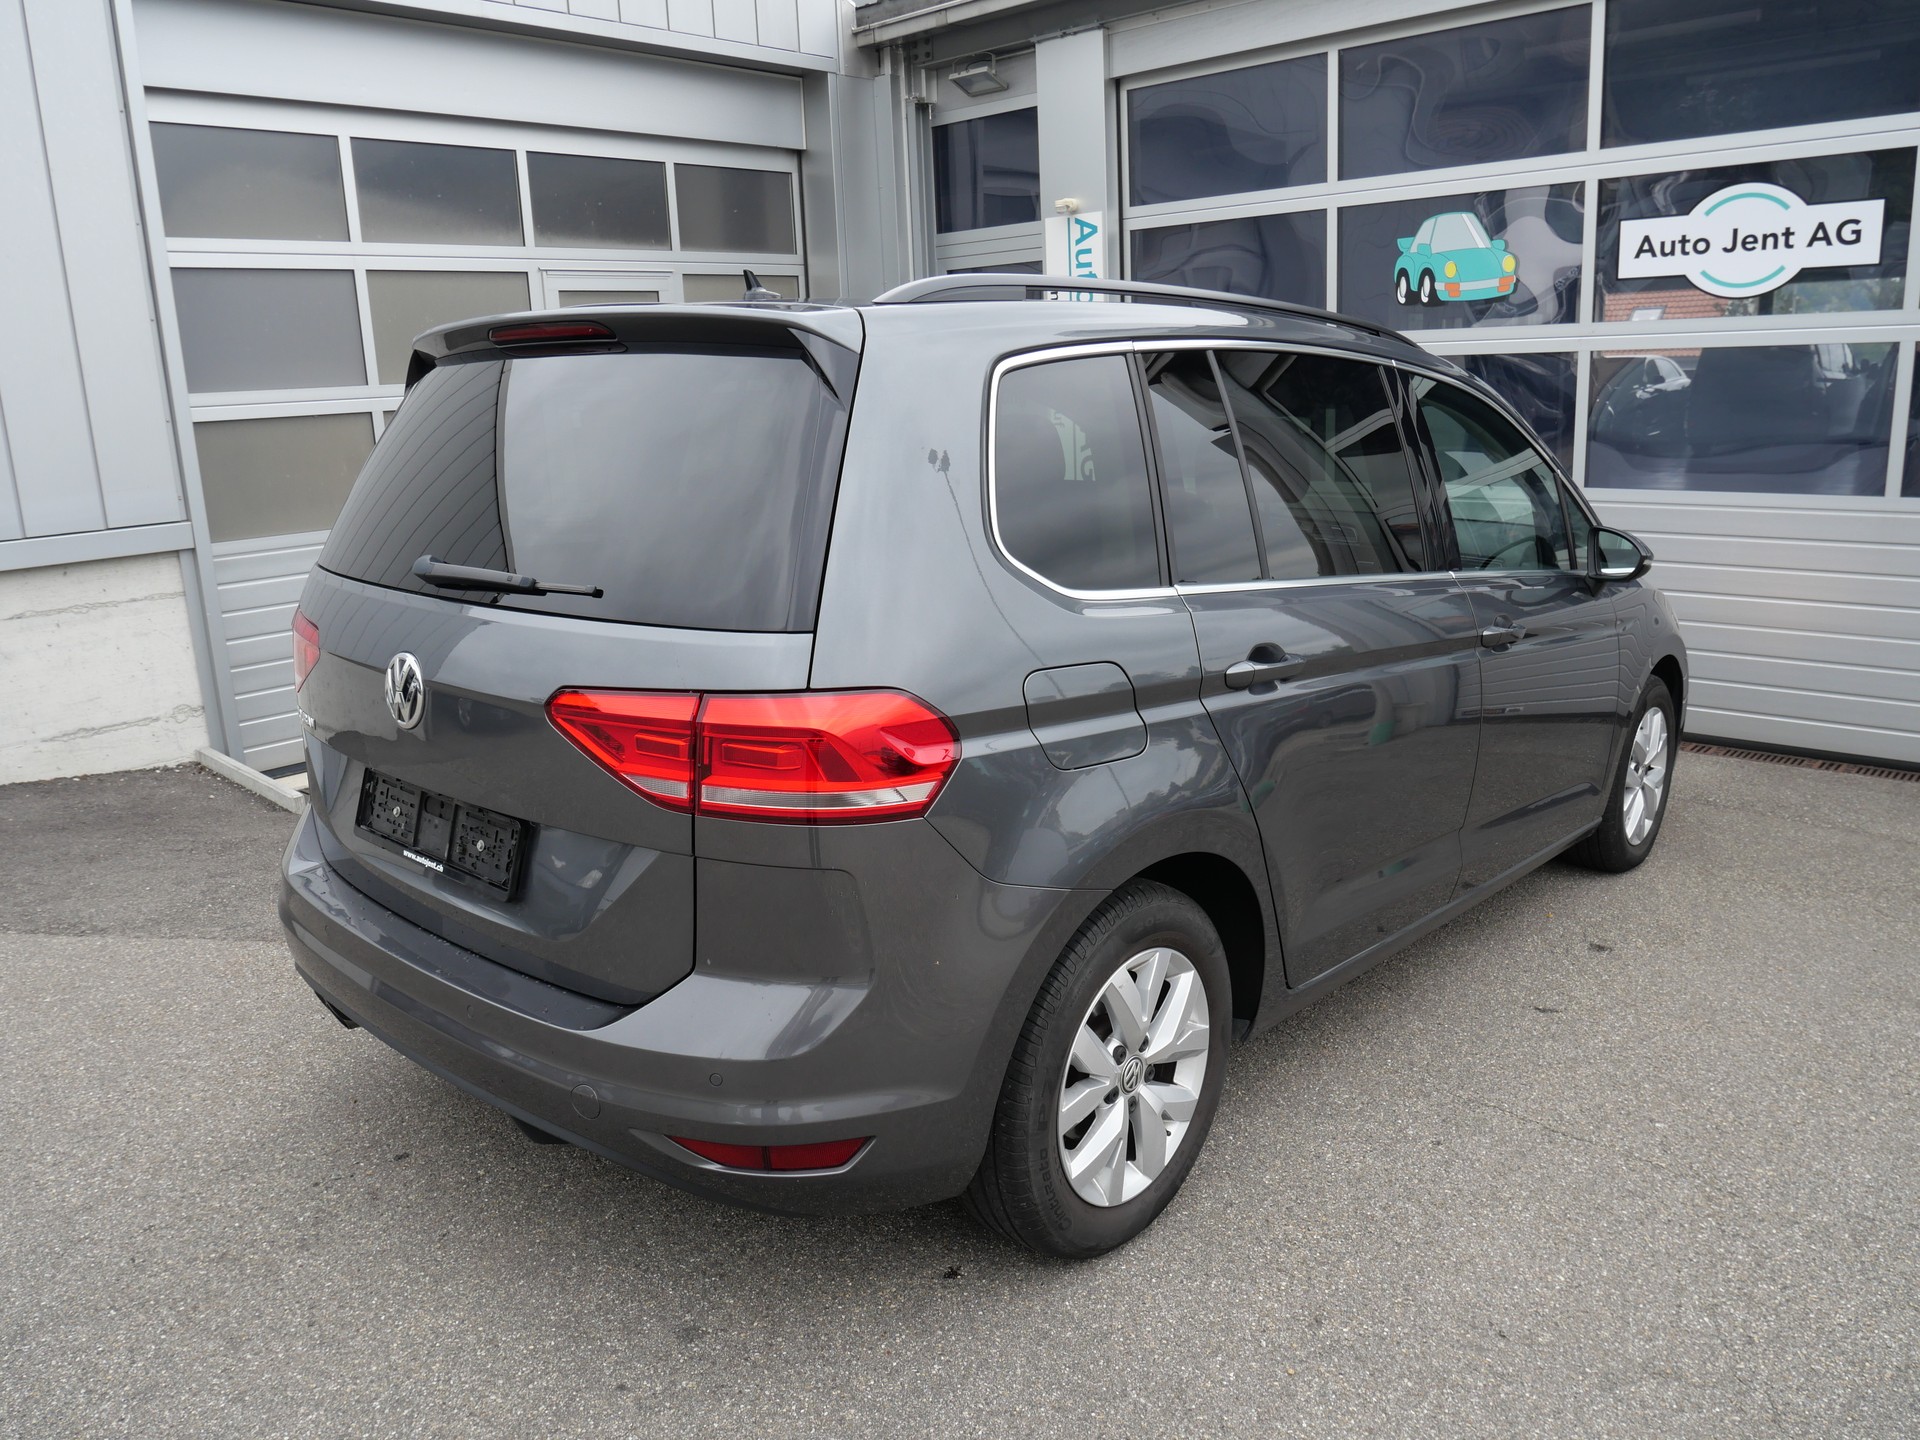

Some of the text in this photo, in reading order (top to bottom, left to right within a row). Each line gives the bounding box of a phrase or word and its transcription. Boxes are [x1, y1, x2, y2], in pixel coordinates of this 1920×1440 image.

[1634, 219, 1862, 259] Auto Jent AG
